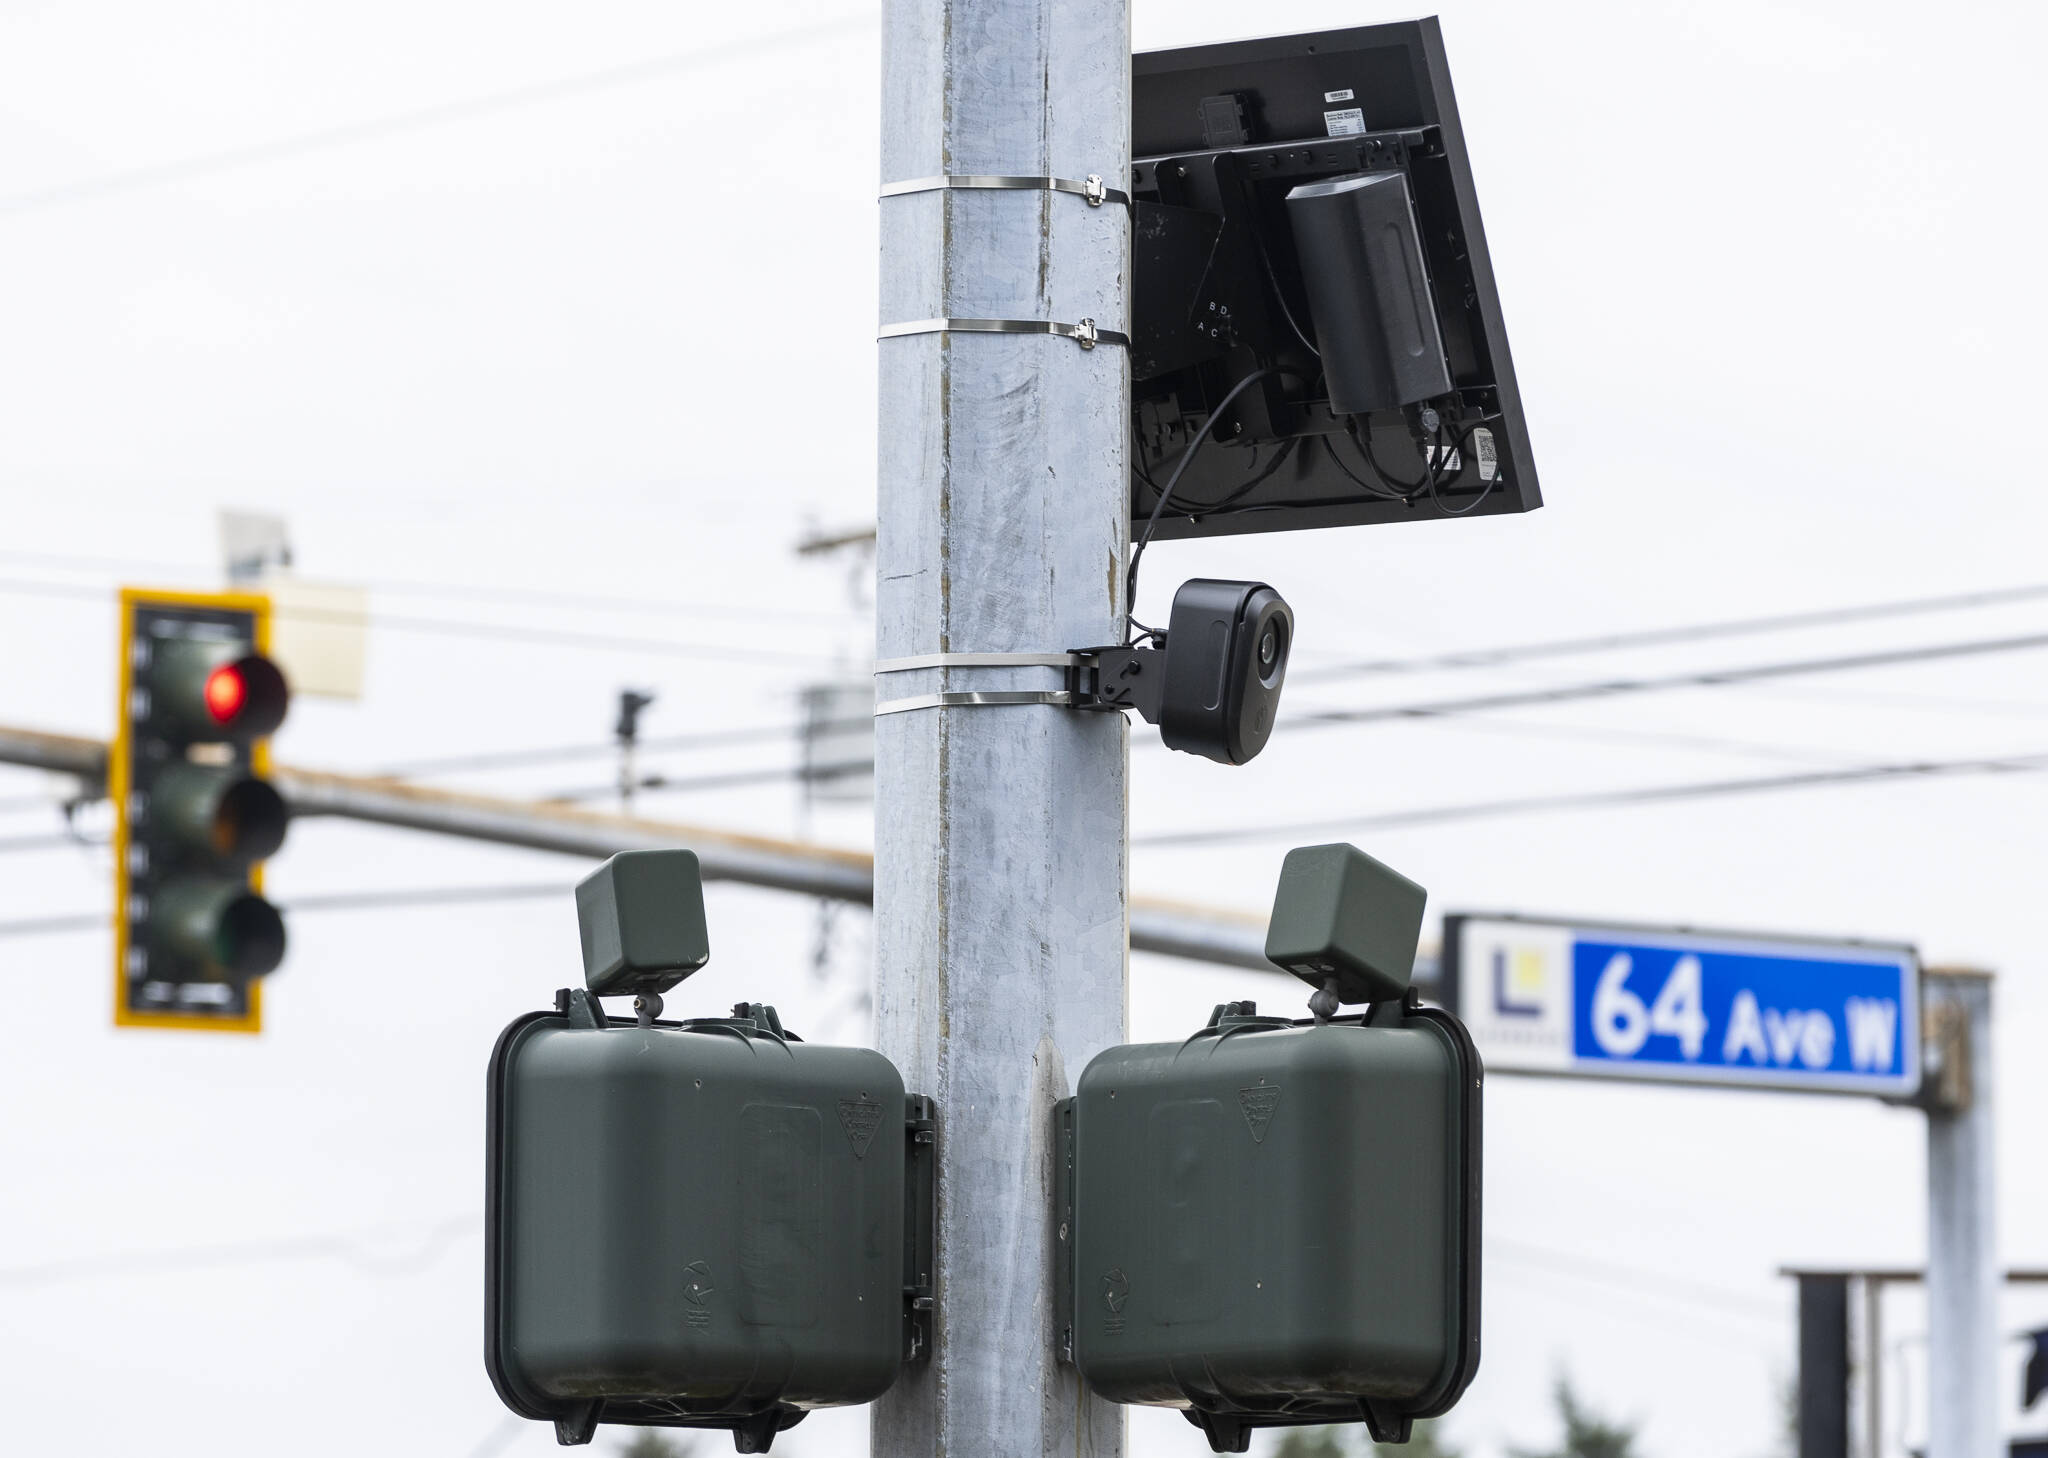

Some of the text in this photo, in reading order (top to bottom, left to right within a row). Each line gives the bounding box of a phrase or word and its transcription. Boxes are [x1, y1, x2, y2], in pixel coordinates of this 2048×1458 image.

[1210, 301, 1227, 315] B D
[1197, 321, 1218, 337] A C
[1591, 951, 1897, 1070] 64 Ave W
